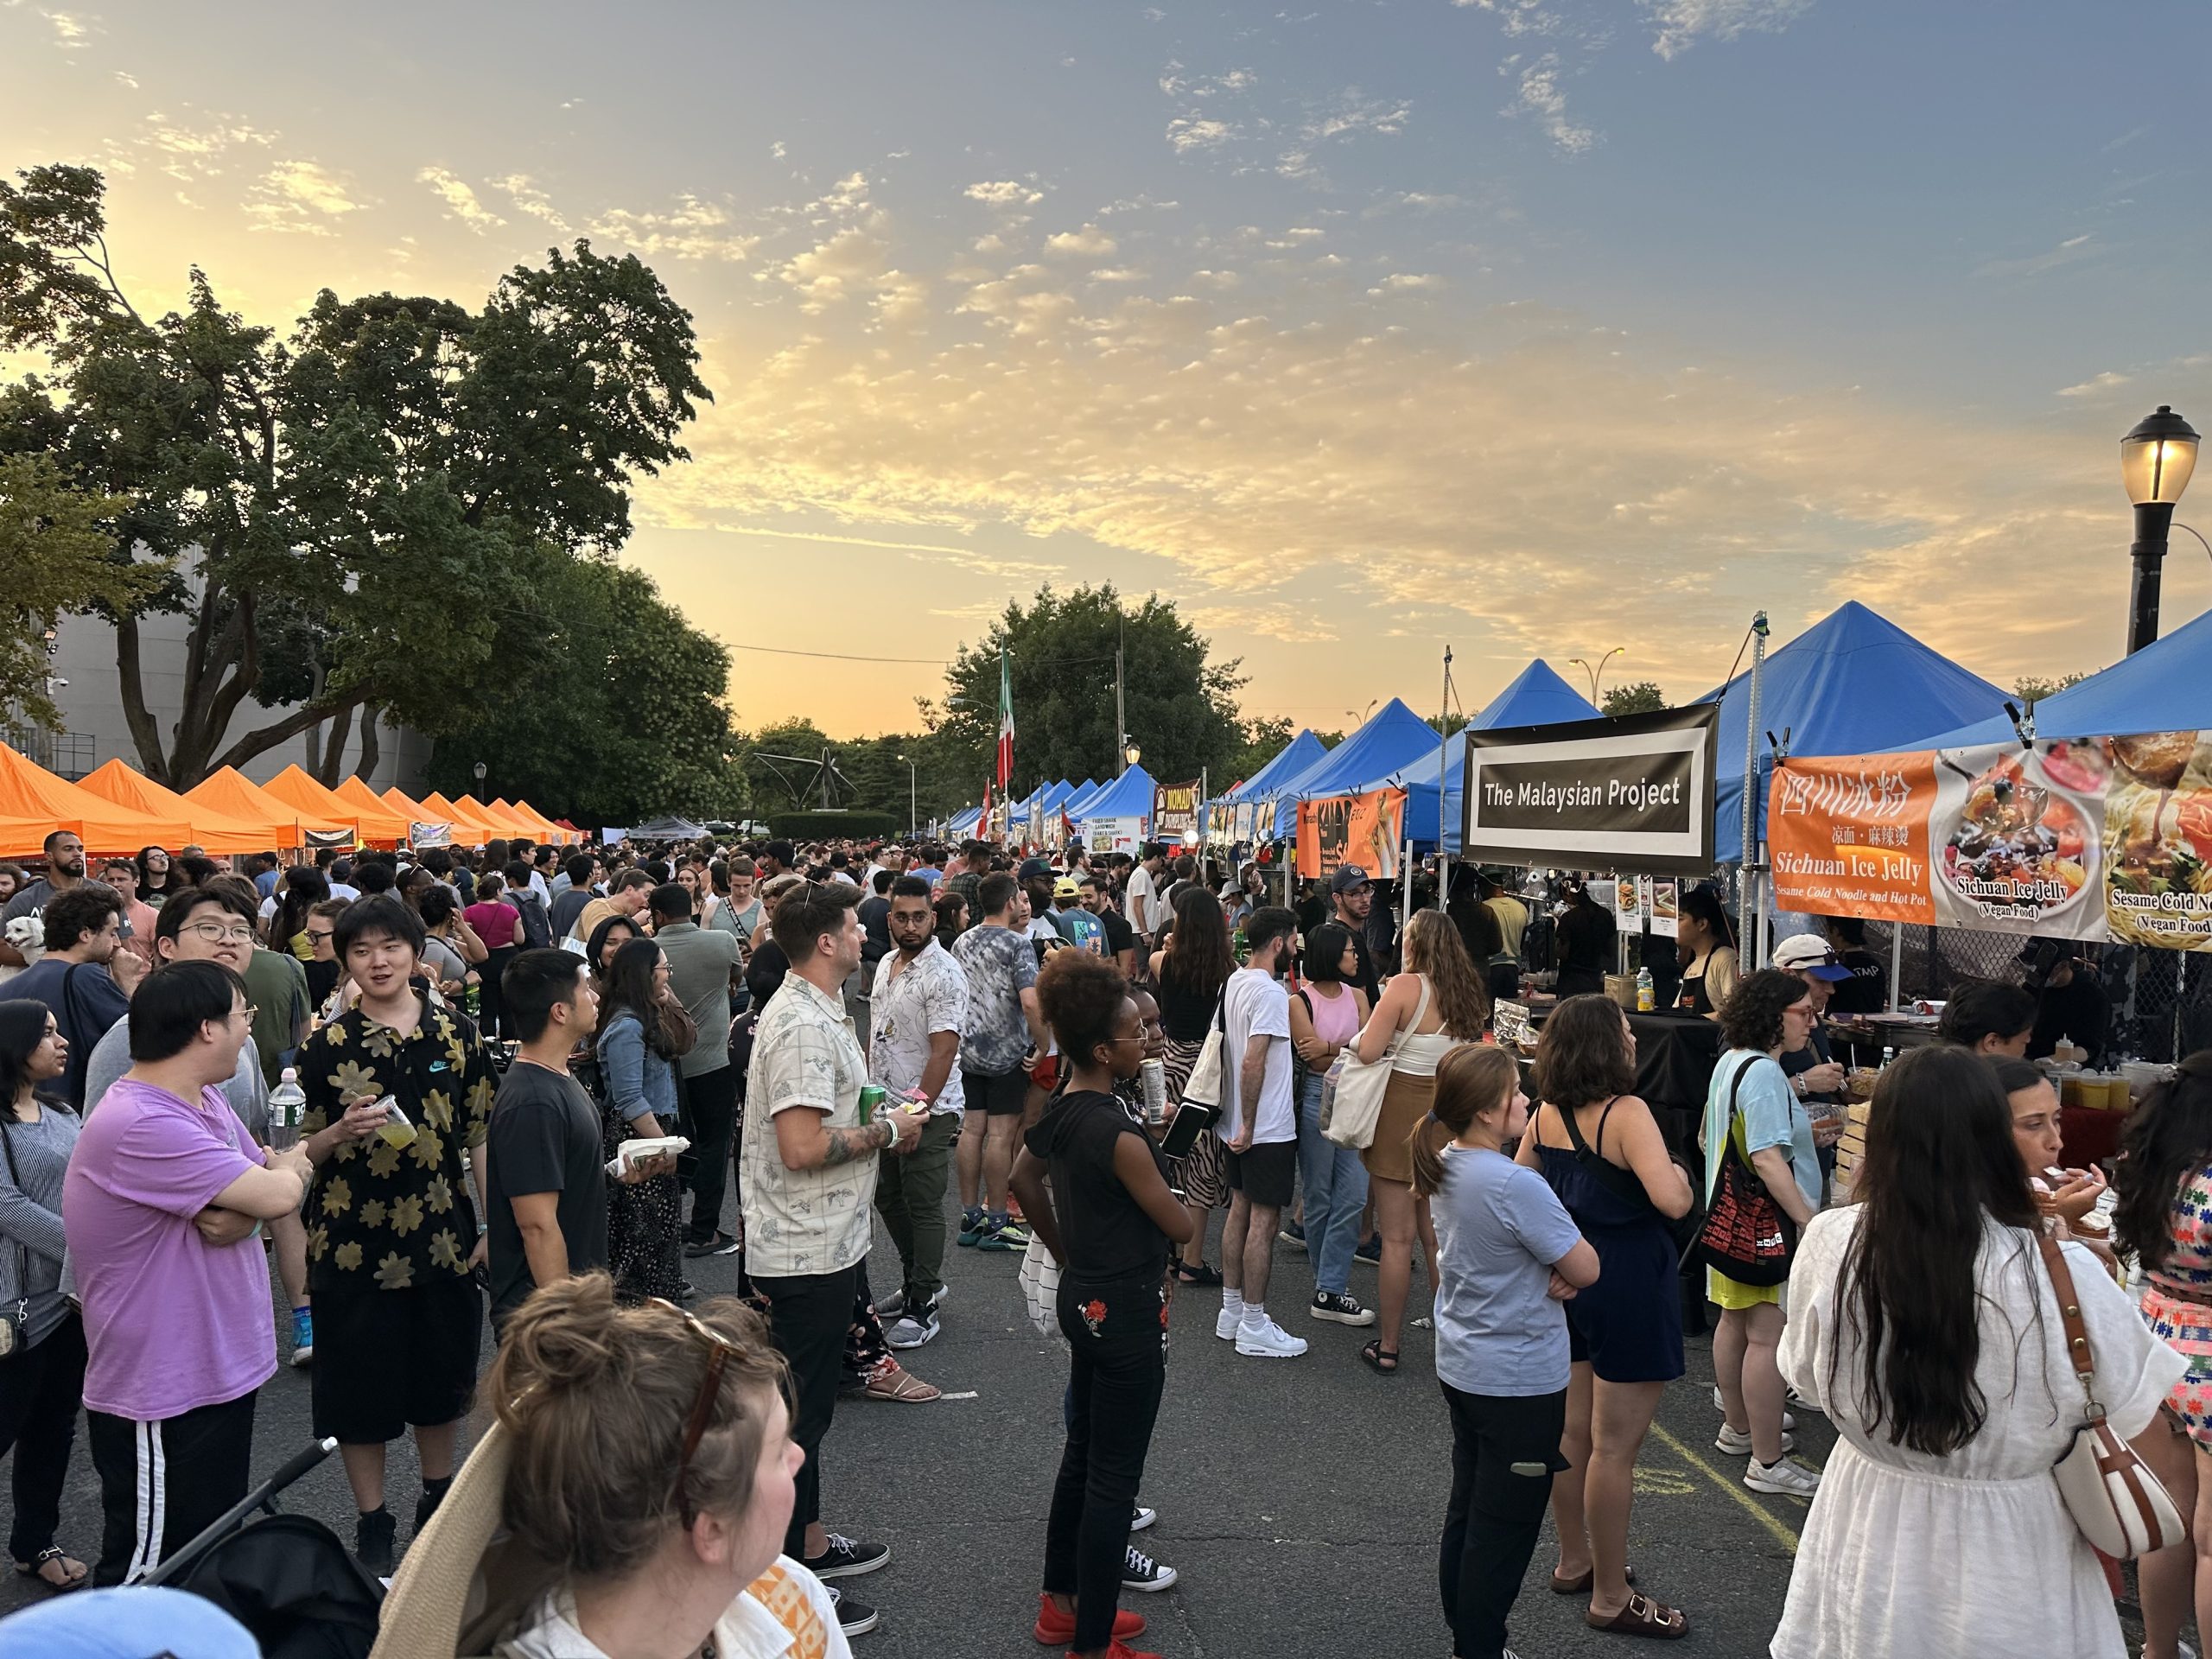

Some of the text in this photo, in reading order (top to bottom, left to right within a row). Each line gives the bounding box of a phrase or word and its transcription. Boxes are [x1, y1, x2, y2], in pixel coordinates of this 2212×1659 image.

[1167, 787, 1191, 810] NOMAD
[1484, 777, 1681, 813] The Malaysian Project
[1781, 770, 1912, 817] 四川冰粉
[1165, 813, 1192, 830] DUMPLINGS
[1776, 851, 1923, 887] Sichuan Ice Jelly
[1777, 883, 1927, 906] Sesame Cold Noodle and Hot Pot
[1957, 878, 2068, 904] Sichuan Ice Jelly
[2113, 890, 2158, 908] Sesame
[2162, 893, 2194, 910] Cold
[1980, 903, 2038, 919] (Vegan Food)
[2137, 916, 2177, 932] (Vegan
[1757, 1232, 1783, 1247] WNYC
